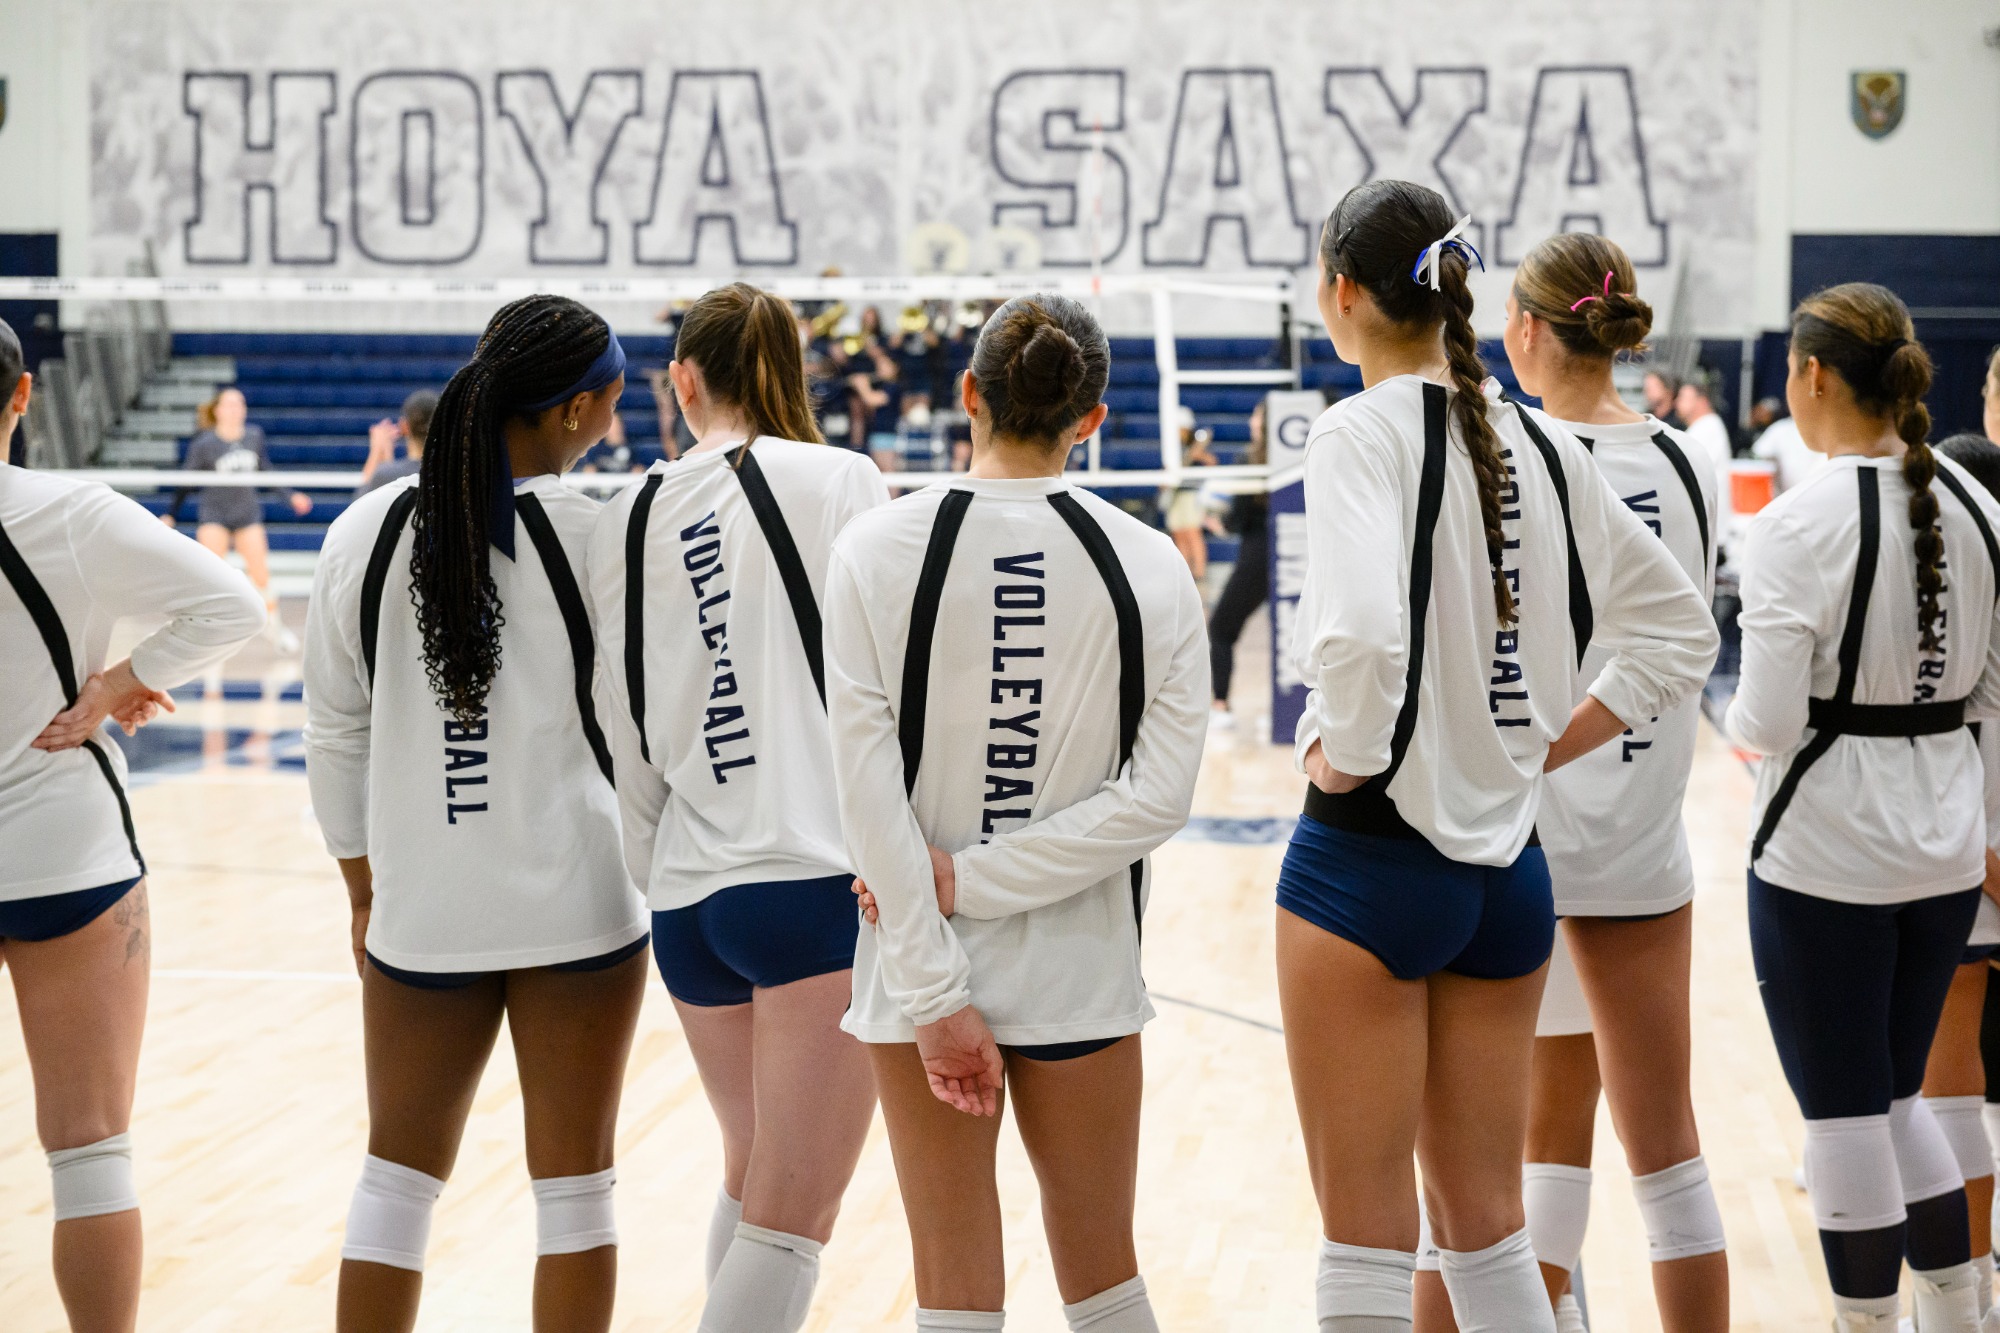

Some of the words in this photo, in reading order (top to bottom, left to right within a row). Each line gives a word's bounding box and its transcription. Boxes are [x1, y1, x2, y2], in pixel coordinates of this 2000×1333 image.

[184, 70, 798, 266] HOYA
[991, 66, 1669, 268] SAXA
[444, 697, 489, 825] BALL
[980, 551, 1046, 844] VOLLEYBAL
